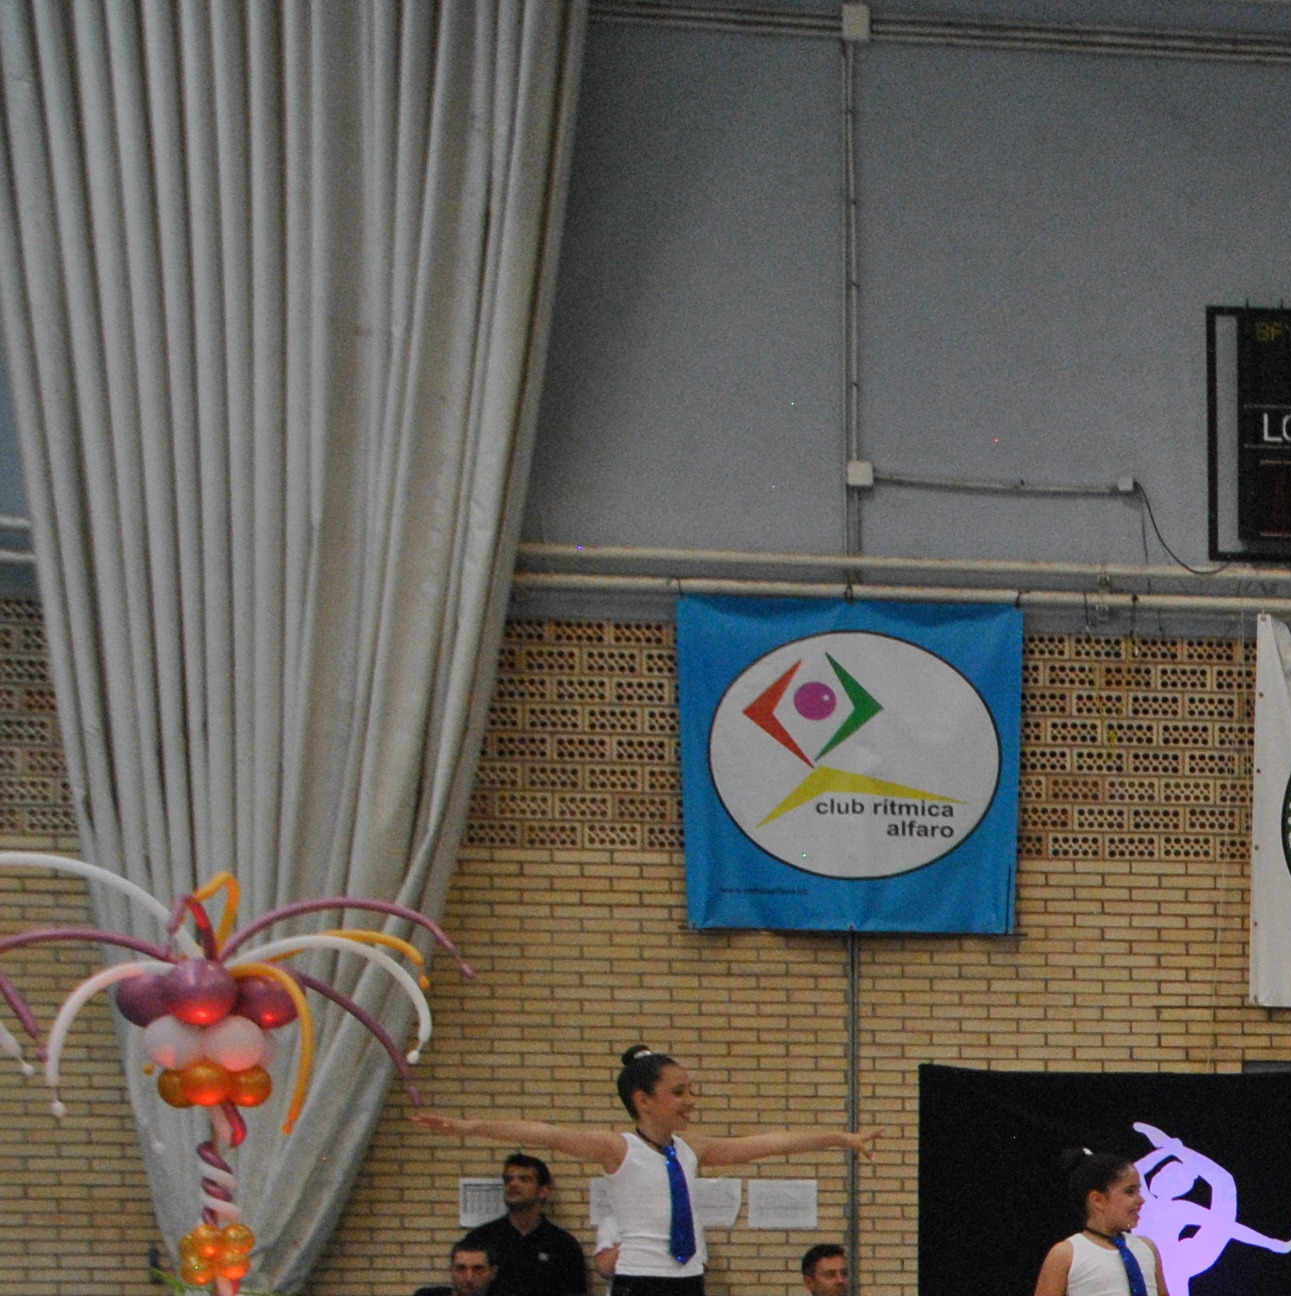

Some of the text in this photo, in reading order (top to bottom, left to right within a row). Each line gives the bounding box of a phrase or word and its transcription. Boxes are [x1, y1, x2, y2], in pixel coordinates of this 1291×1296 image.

[816, 798, 954, 817] club ritmica
[887, 820, 954, 838] alfaro
